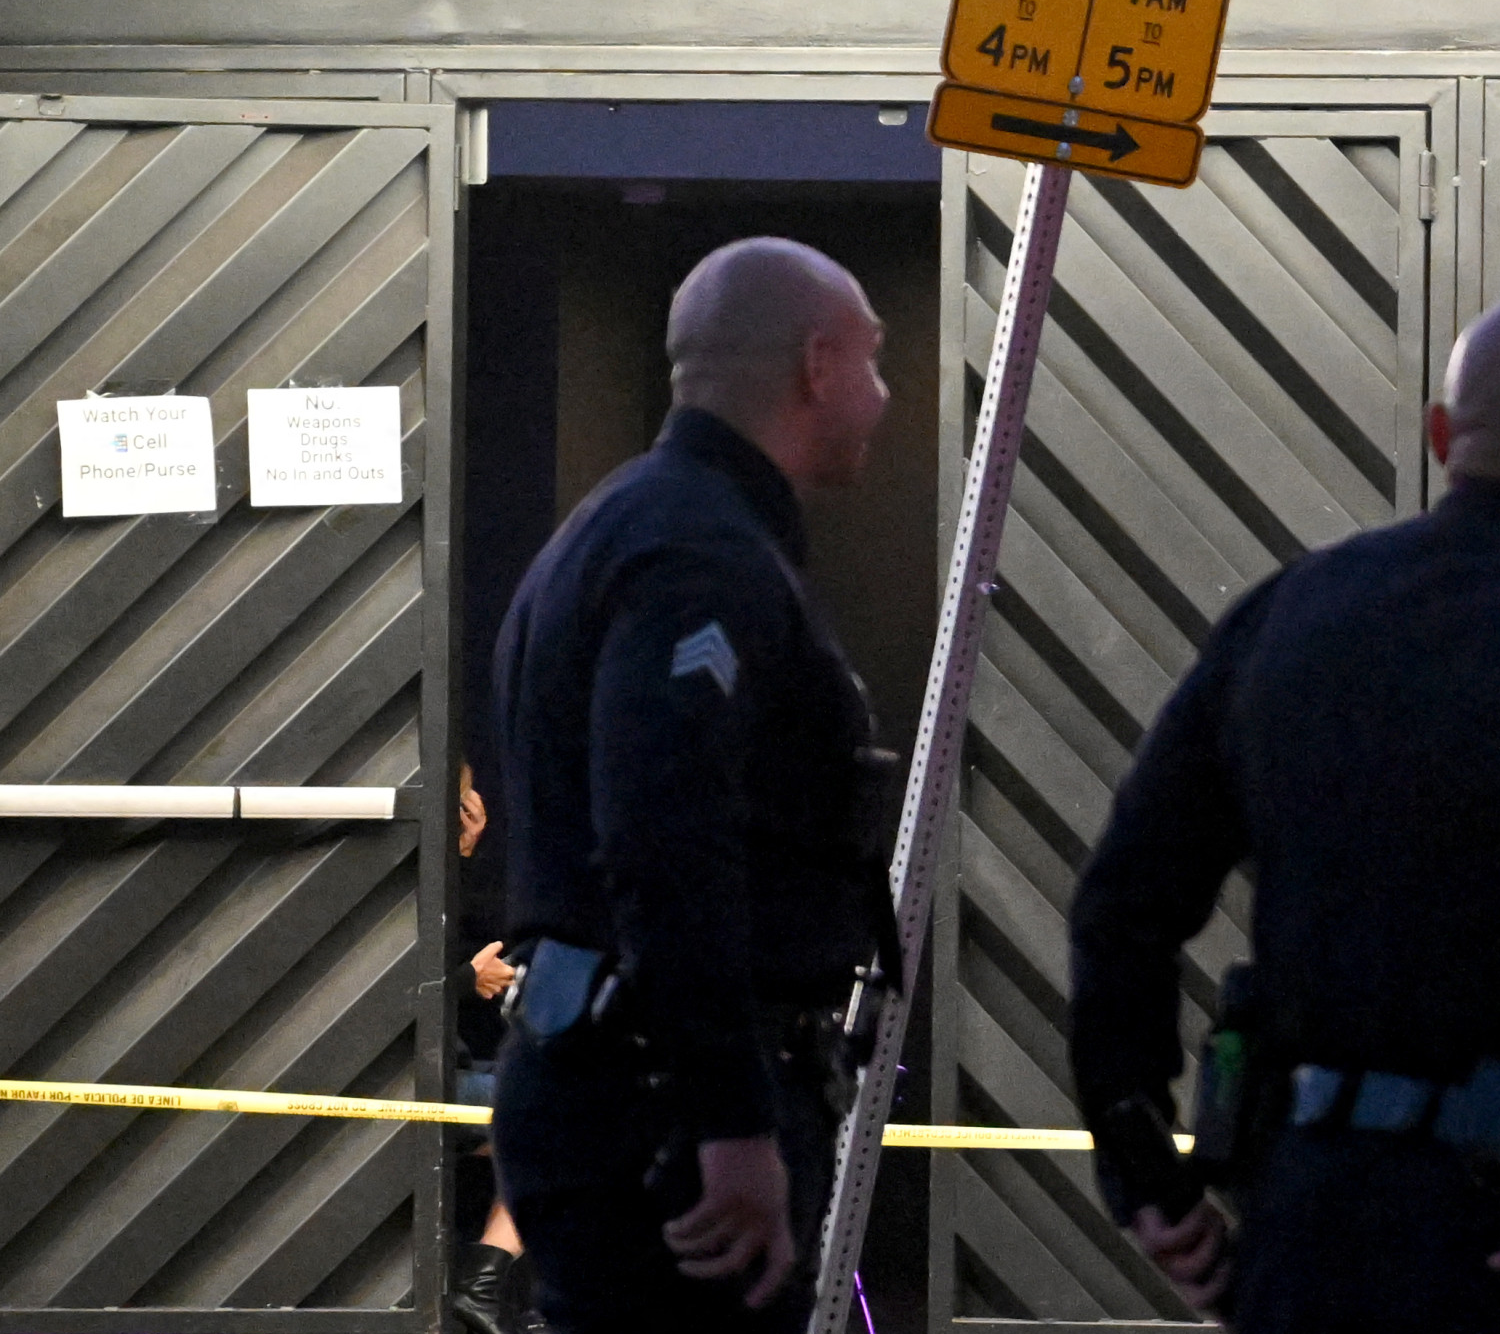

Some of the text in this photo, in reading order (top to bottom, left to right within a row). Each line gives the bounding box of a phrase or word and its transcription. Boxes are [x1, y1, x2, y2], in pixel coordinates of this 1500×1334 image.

[1144, 21, 1163, 41] TO
[975, 24, 1051, 76] 4PM
[1103, 45, 1175, 99] 5PM
[83, 407, 186, 423] Watch Your
[287, 416, 361, 430] Weapons
[133, 433, 167, 449] Cell
[301, 433, 347, 448] Drugs
[302, 449, 352, 463] Drinks
[80, 463, 196, 479] Phone/Purse
[266, 467, 384, 481] No In and Outs
[11, 1089, 46, 1101] FAVOR
[49, 1091, 71, 1101] POR
[83, 1092, 127, 1104] POLICIA
[131, 1094, 144, 1105] DE
[148, 1094, 181, 1106] LINEA
